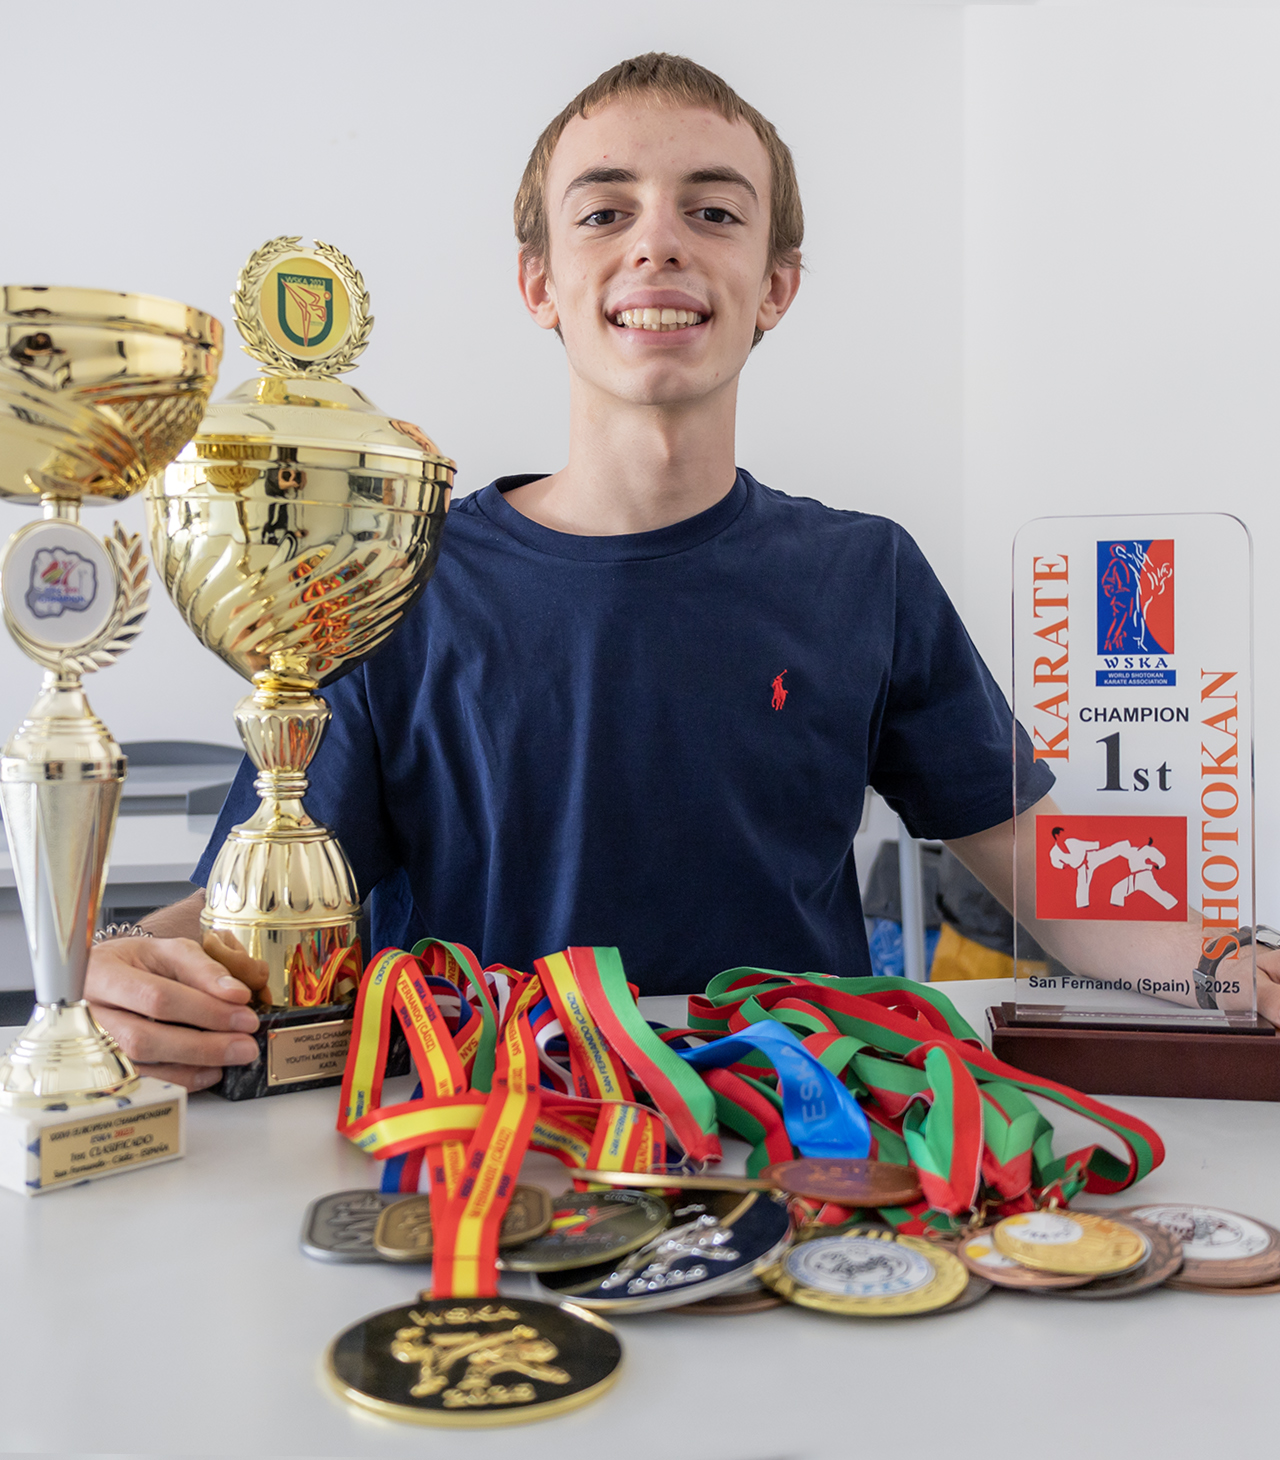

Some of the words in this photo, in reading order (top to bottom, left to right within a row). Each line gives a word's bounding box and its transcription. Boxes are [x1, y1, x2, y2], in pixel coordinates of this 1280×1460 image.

[1033, 554, 1069, 763] KARATE
[1104, 657, 1168, 669] WSKA
[1079, 707, 1189, 722] CHAMPION
[1096, 732, 1172, 791] 1st
[1201, 668, 1240, 960] SHOTOKAN
[1029, 976, 1056, 988] San
[1062, 978, 1132, 990] Fernando
[1137, 978, 1190, 995] (Spain)
[1205, 980, 1240, 994] 2025
[399, 980, 424, 1022] FERNANDO
[294, 1033, 321, 1043] WORLD
[460, 1038, 478, 1059] SAN
[511, 1041, 522, 1056] SAN
[581, 1025, 607, 1074] FERNANDO
[285, 1055, 310, 1063] YOUTH
[319, 1061, 337, 1069] KATA
[603, 1075, 614, 1093] SAN
